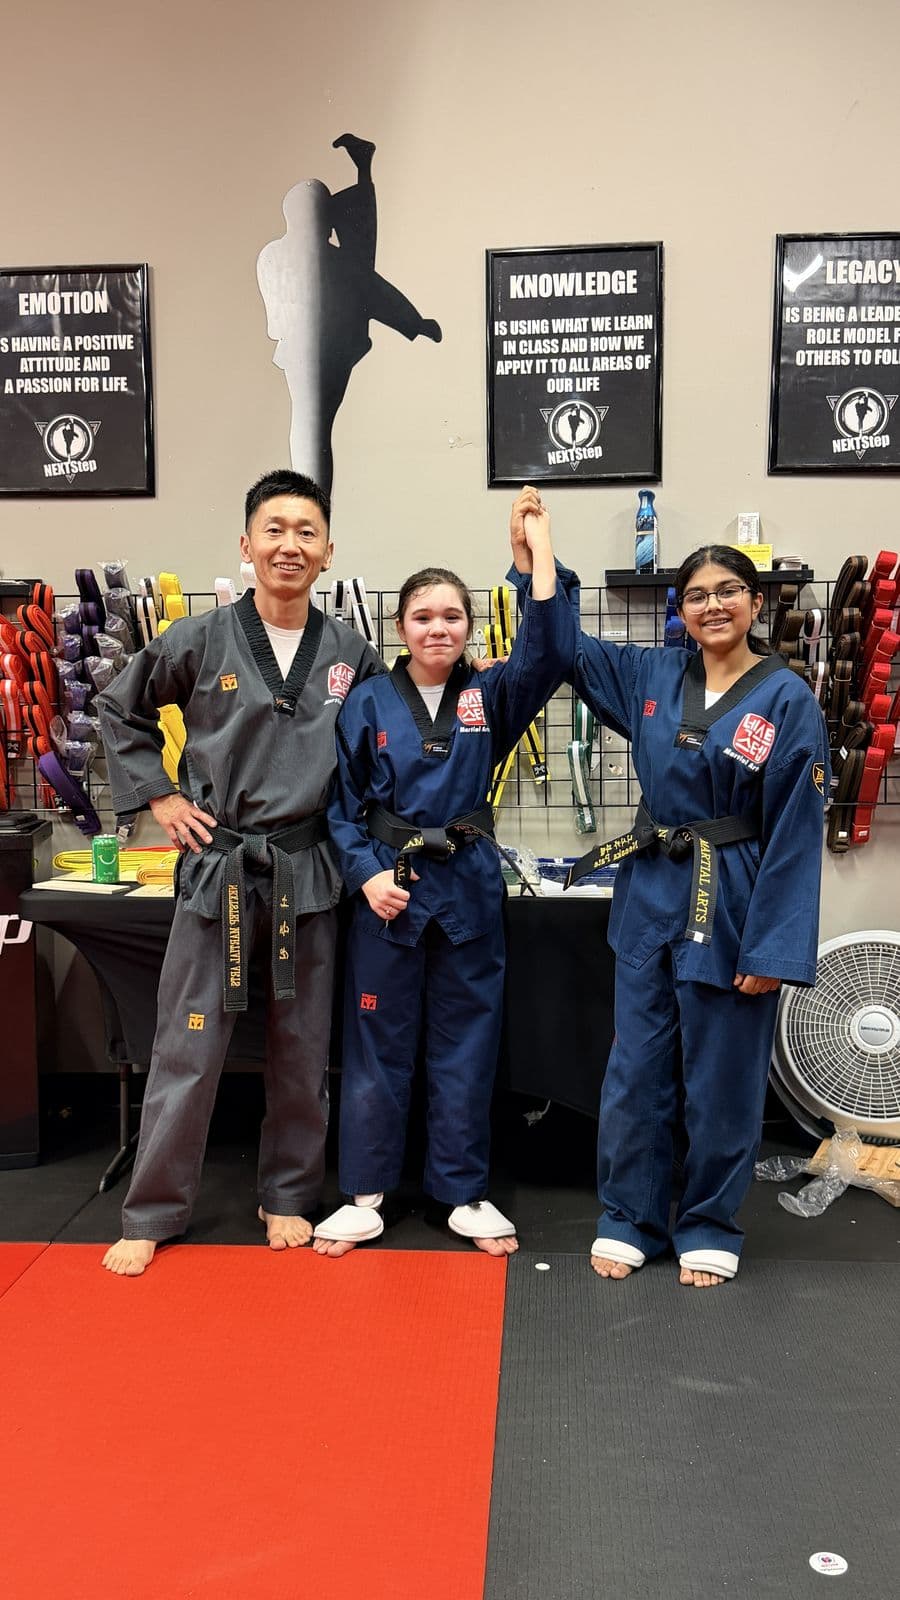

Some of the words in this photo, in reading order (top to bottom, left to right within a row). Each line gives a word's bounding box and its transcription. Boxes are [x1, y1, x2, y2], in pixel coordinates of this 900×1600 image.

[826, 259, 900, 285] LEGACY
[509, 270, 638, 299] KNOWLEDGE
[18, 290, 108, 316] EMOTION
[785, 307, 801, 323] IS
[803, 306, 846, 323] BEING
[848, 306, 858, 322] A
[494, 320, 508, 336] IS
[509, 319, 550, 336] USING
[552, 317, 590, 334] WHAT
[591, 316, 612, 332] WE
[614, 314, 653, 331] LEARN
[11, 336, 61, 353] HAVING
[63, 337, 73, 352] A
[75, 335, 134, 351] POSITIVE
[502, 340, 517, 356] IN
[519, 338, 560, 355] CLASS
[561, 337, 588, 353] AND
[590, 336, 622, 352] HOW
[624, 335, 645, 350] WE
[806, 328, 841, 345] ROLE
[843, 328, 891, 344] MODEL
[20, 357, 81, 373] ATTITUDE
[83, 356, 110, 372] AND
[496, 360, 534, 376] APPLY
[535, 359, 548, 374] IT
[550, 358, 567, 374] TO
[569, 357, 590, 373] ALL
[592, 356, 633, 372] AREAS
[635, 354, 652, 370] OF
[795, 350, 851, 366] OTHERS
[853, 349, 872, 366] TO
[874, 349, 900, 366] FOL
[4, 379, 14, 394] A
[16, 378, 72, 394] PASSION
[75, 377, 101, 393] FOR
[102, 376, 128, 392] LIFE
[546, 377, 573, 393] OUR
[575, 377, 600, 392] LIFE
[832, 434, 890, 453] NEXTStep
[547, 446, 603, 465] NEXTStep
[43, 459, 98, 477] NEXTStep
[723, 747, 750, 766] Martial
[698, 838, 711, 886] MARTIAL
[695, 888, 710, 923] ARTS
